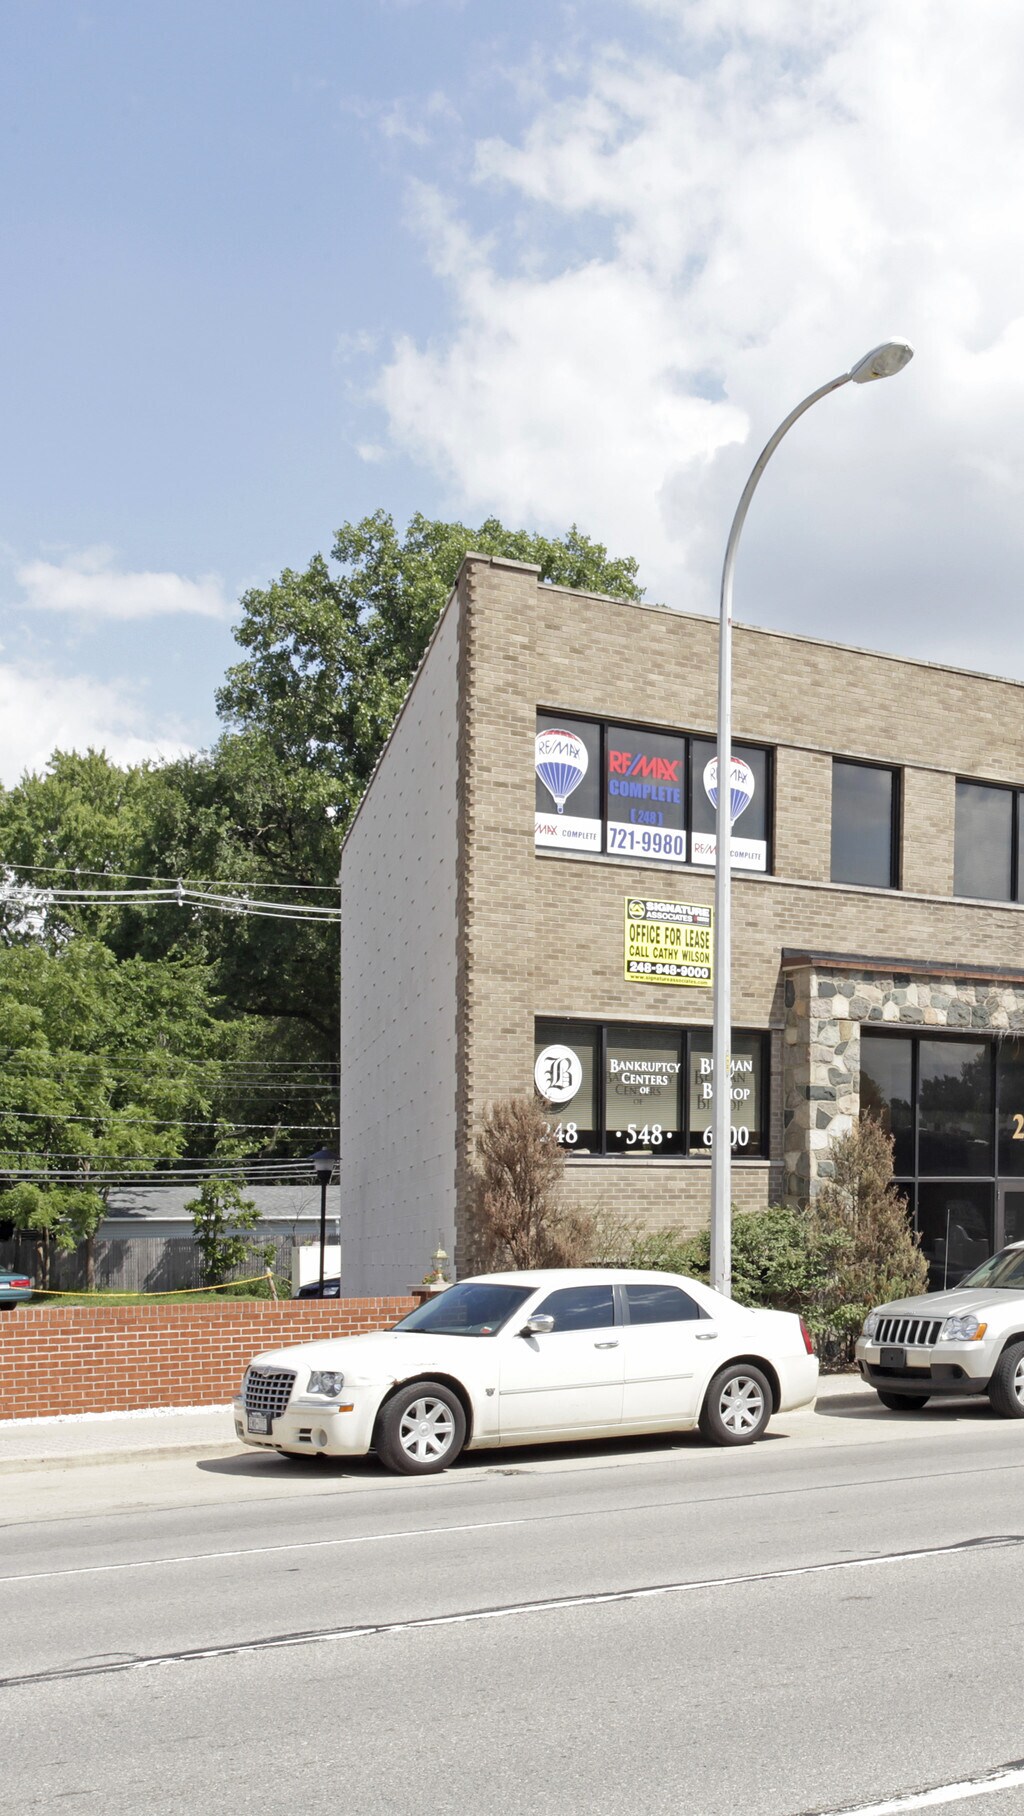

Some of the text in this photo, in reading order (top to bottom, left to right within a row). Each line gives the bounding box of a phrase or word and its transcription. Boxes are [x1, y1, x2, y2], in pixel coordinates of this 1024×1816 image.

[539, 739, 580, 759] RE/MAX
[609, 751, 682, 781] RE/MAX
[609, 779, 681, 804] COMPLETE
[562, 829, 597, 840] COMPLETE
[609, 828, 683, 856] 721-9980
[730, 850, 761, 861] COMPLETE
[646, 902, 710, 917] SIGNATURE
[646, 911, 693, 922] ASSOCIATES
[629, 924, 710, 949] OFFICE FOR LEASE
[629, 945, 710, 963] CALL CATHY WILSON
[629, 961, 709, 979] 248-948-9000
[610, 1059, 681, 1074] BANKRUPTCY
[700, 1057, 753, 1074] BMAN
[621, 1072, 668, 1085] CENTERS
[639, 1086, 650, 1094] OF
[626, 1123, 663, 1145] 548
[703, 1125, 749, 1146] 600
